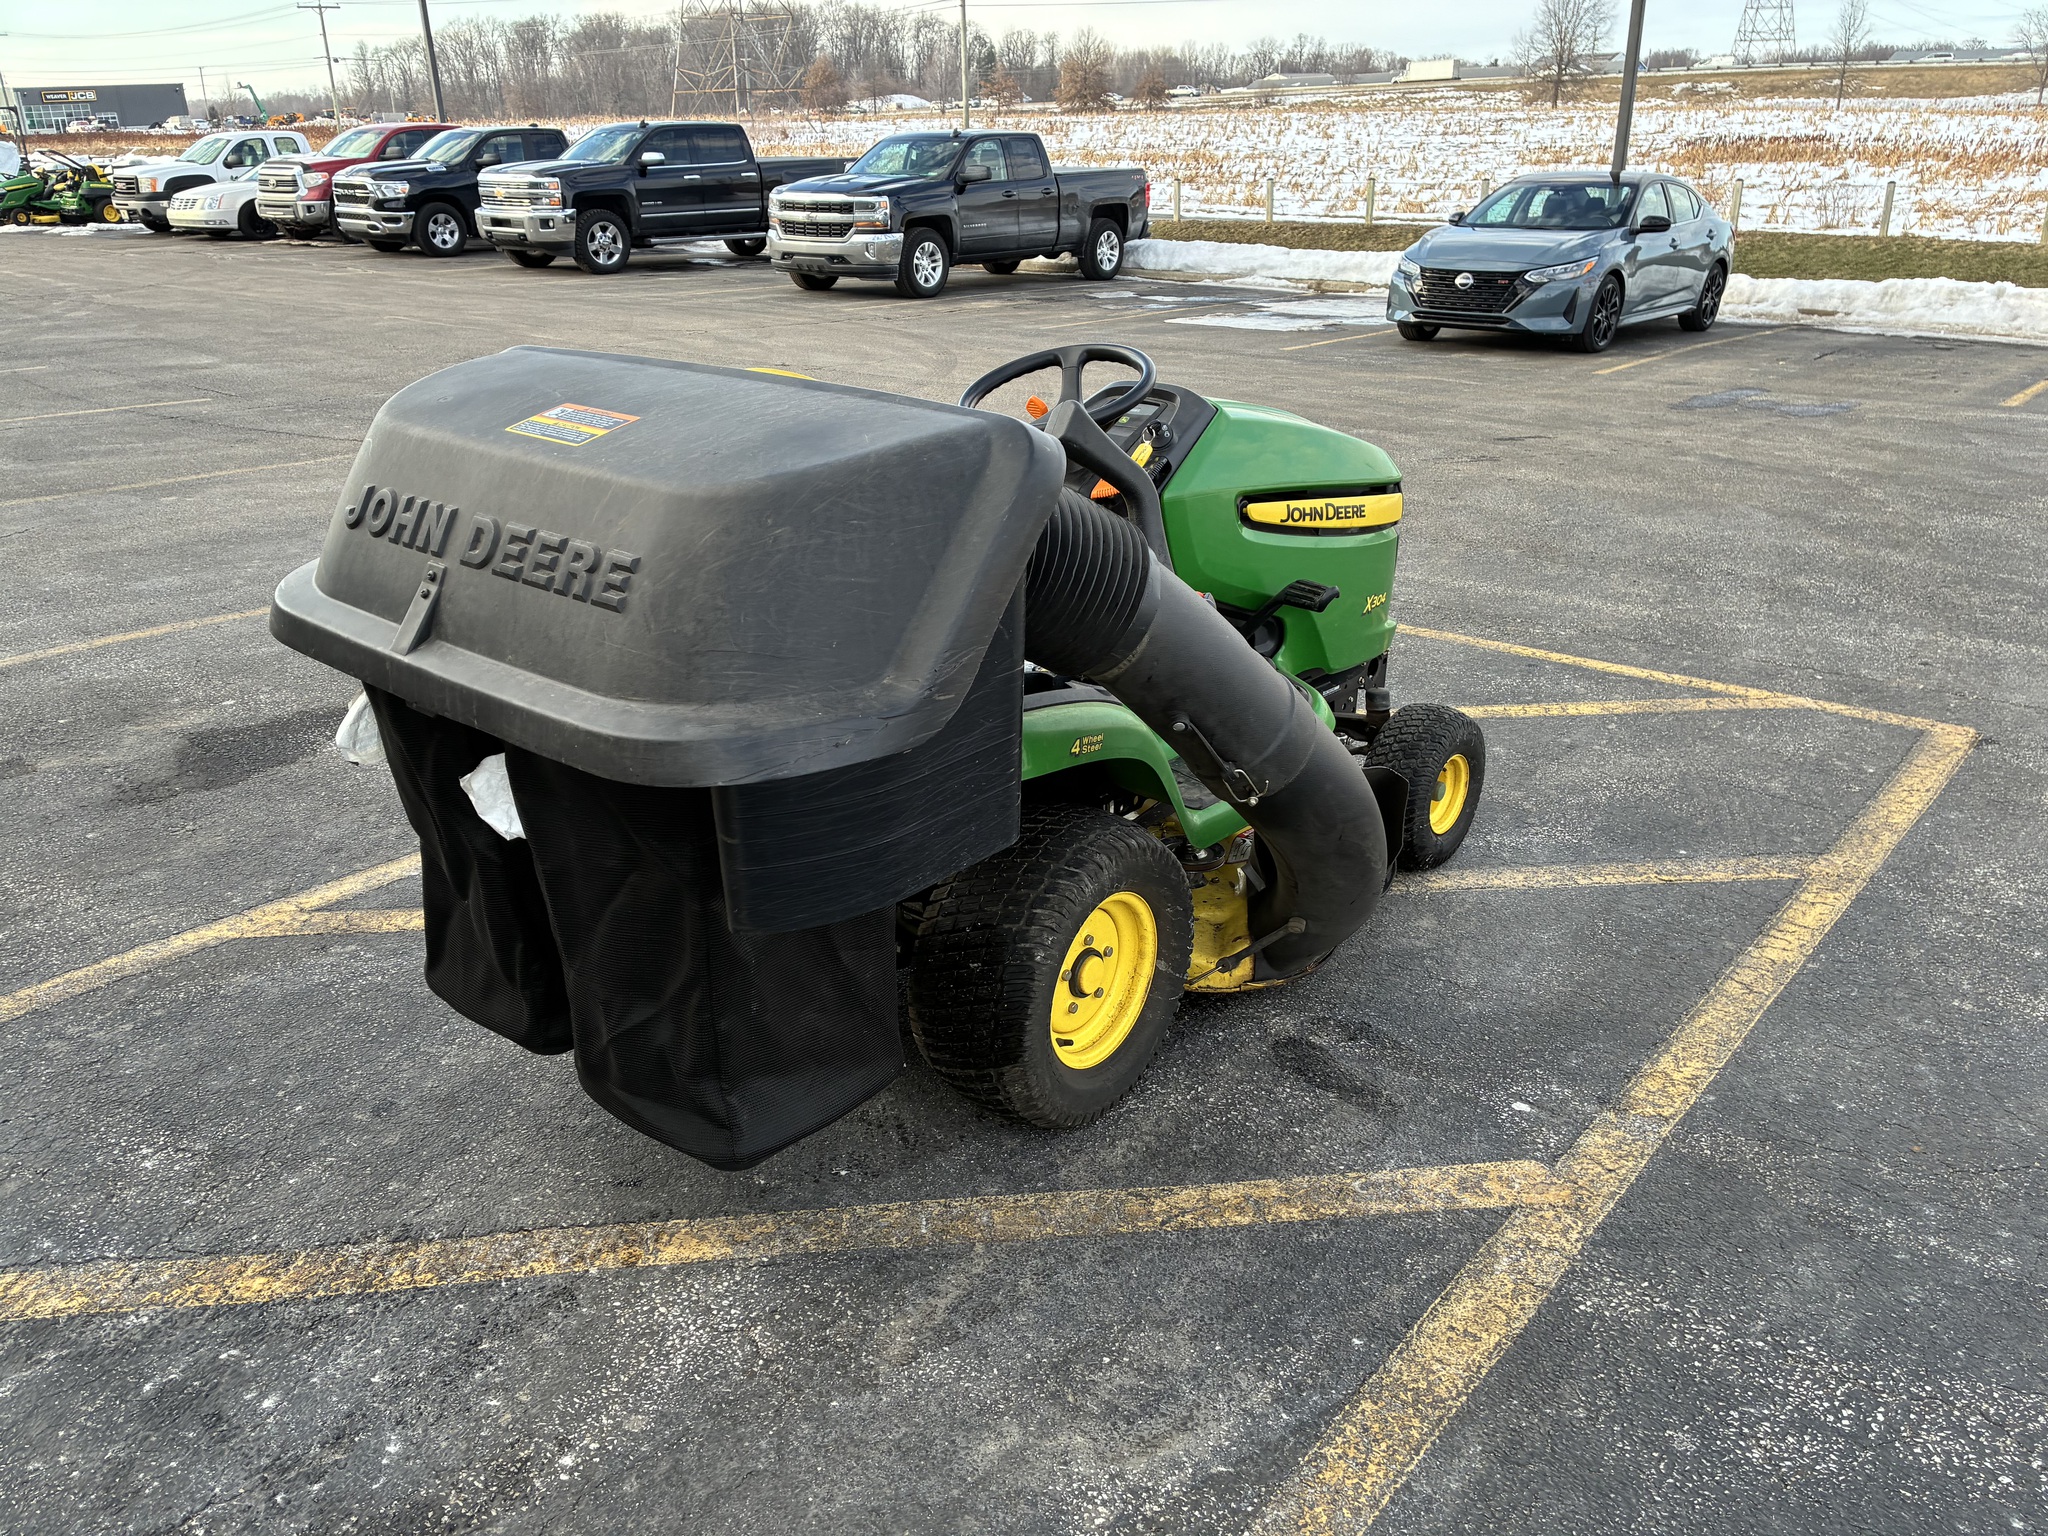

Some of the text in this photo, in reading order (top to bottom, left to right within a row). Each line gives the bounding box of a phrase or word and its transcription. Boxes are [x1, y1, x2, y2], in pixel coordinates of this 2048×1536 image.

[71, 91, 95, 100] JCB
[1280, 502, 1366, 524] JOHN DEERE
[344, 483, 641, 613] JOHN DEERE
[1362, 592, 1387, 616] X304
[1070, 733, 1104, 756] 4 Wheel
[1082, 743, 1103, 754] Steer
